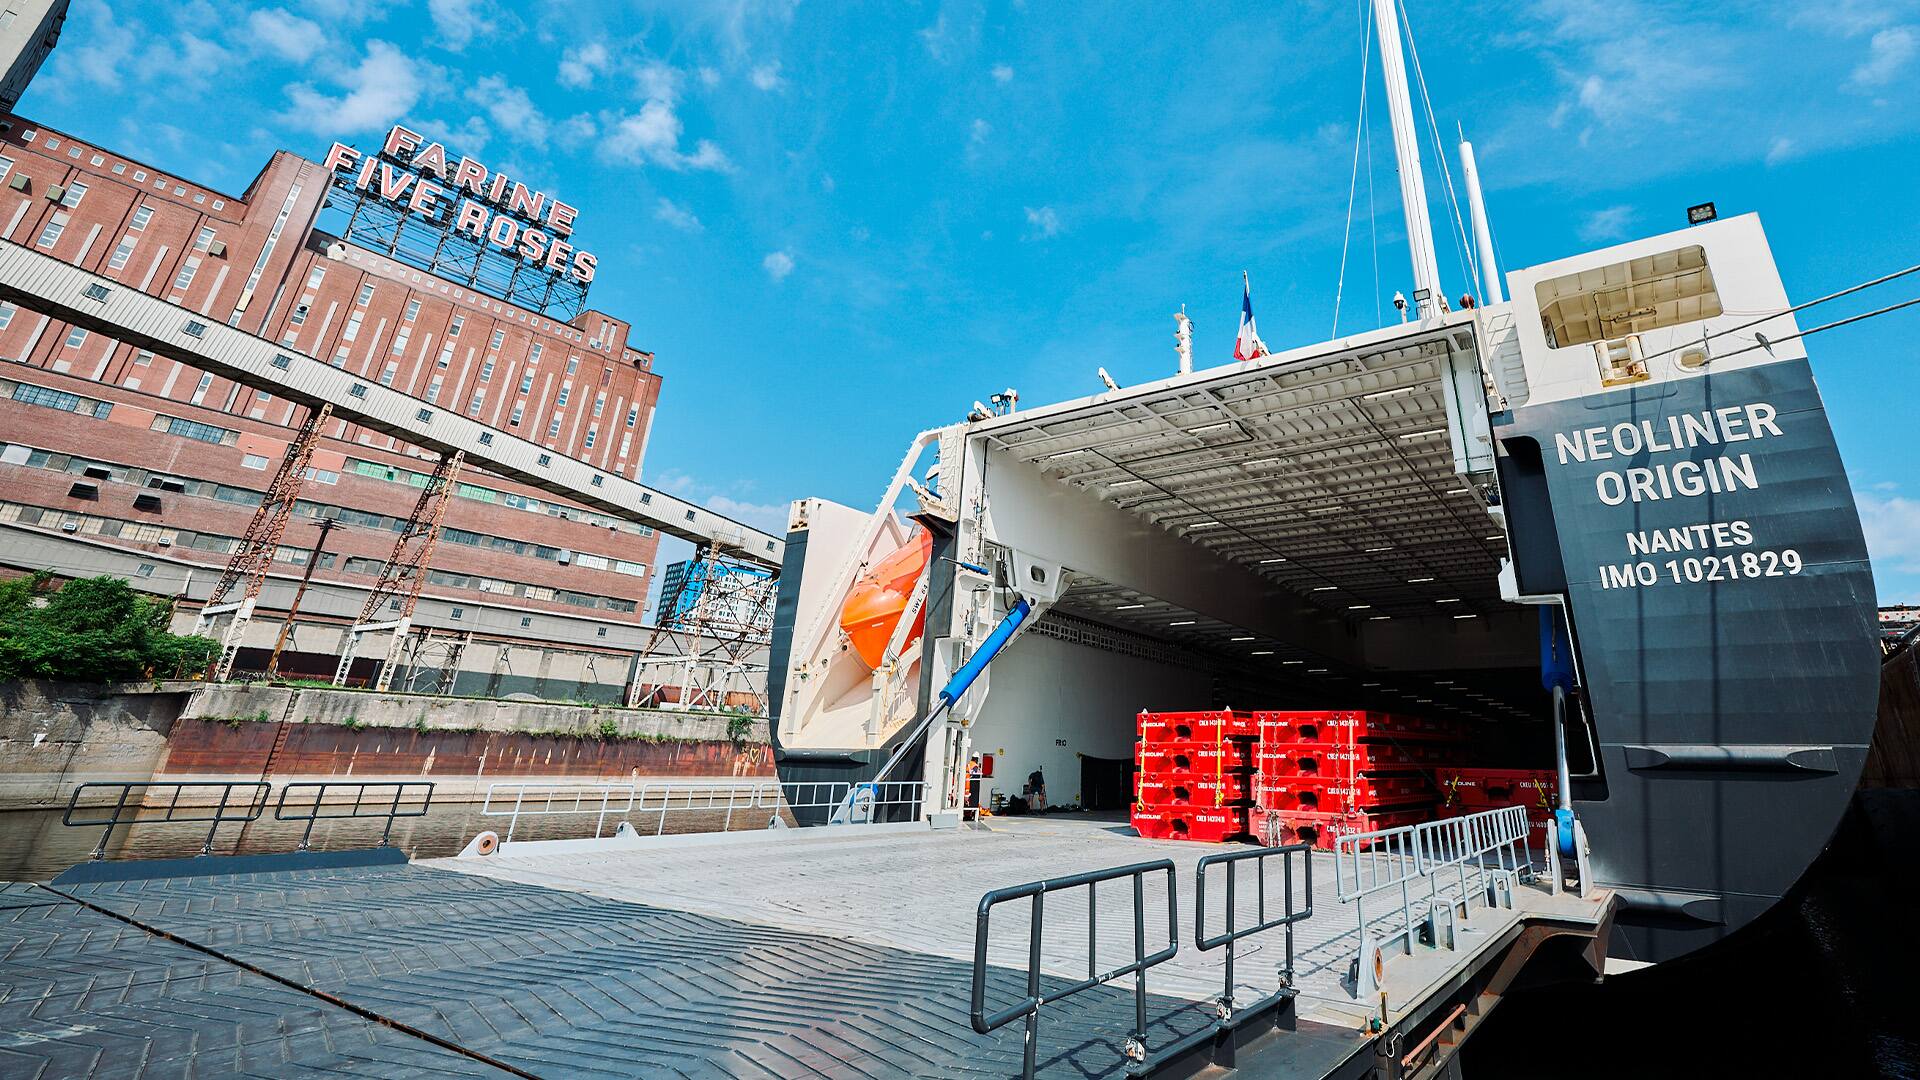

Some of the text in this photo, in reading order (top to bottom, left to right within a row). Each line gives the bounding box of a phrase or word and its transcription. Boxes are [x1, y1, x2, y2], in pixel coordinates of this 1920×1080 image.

[384, 125, 579, 235] FARINE
[324, 142, 598, 283] FIVE ROSES
[1555, 403, 1783, 464] NEOLINER
[1596, 453, 1759, 506] ORIGIN
[1626, 520, 1753, 556] NANTES
[1599, 549, 1802, 590] IMO 1021829
